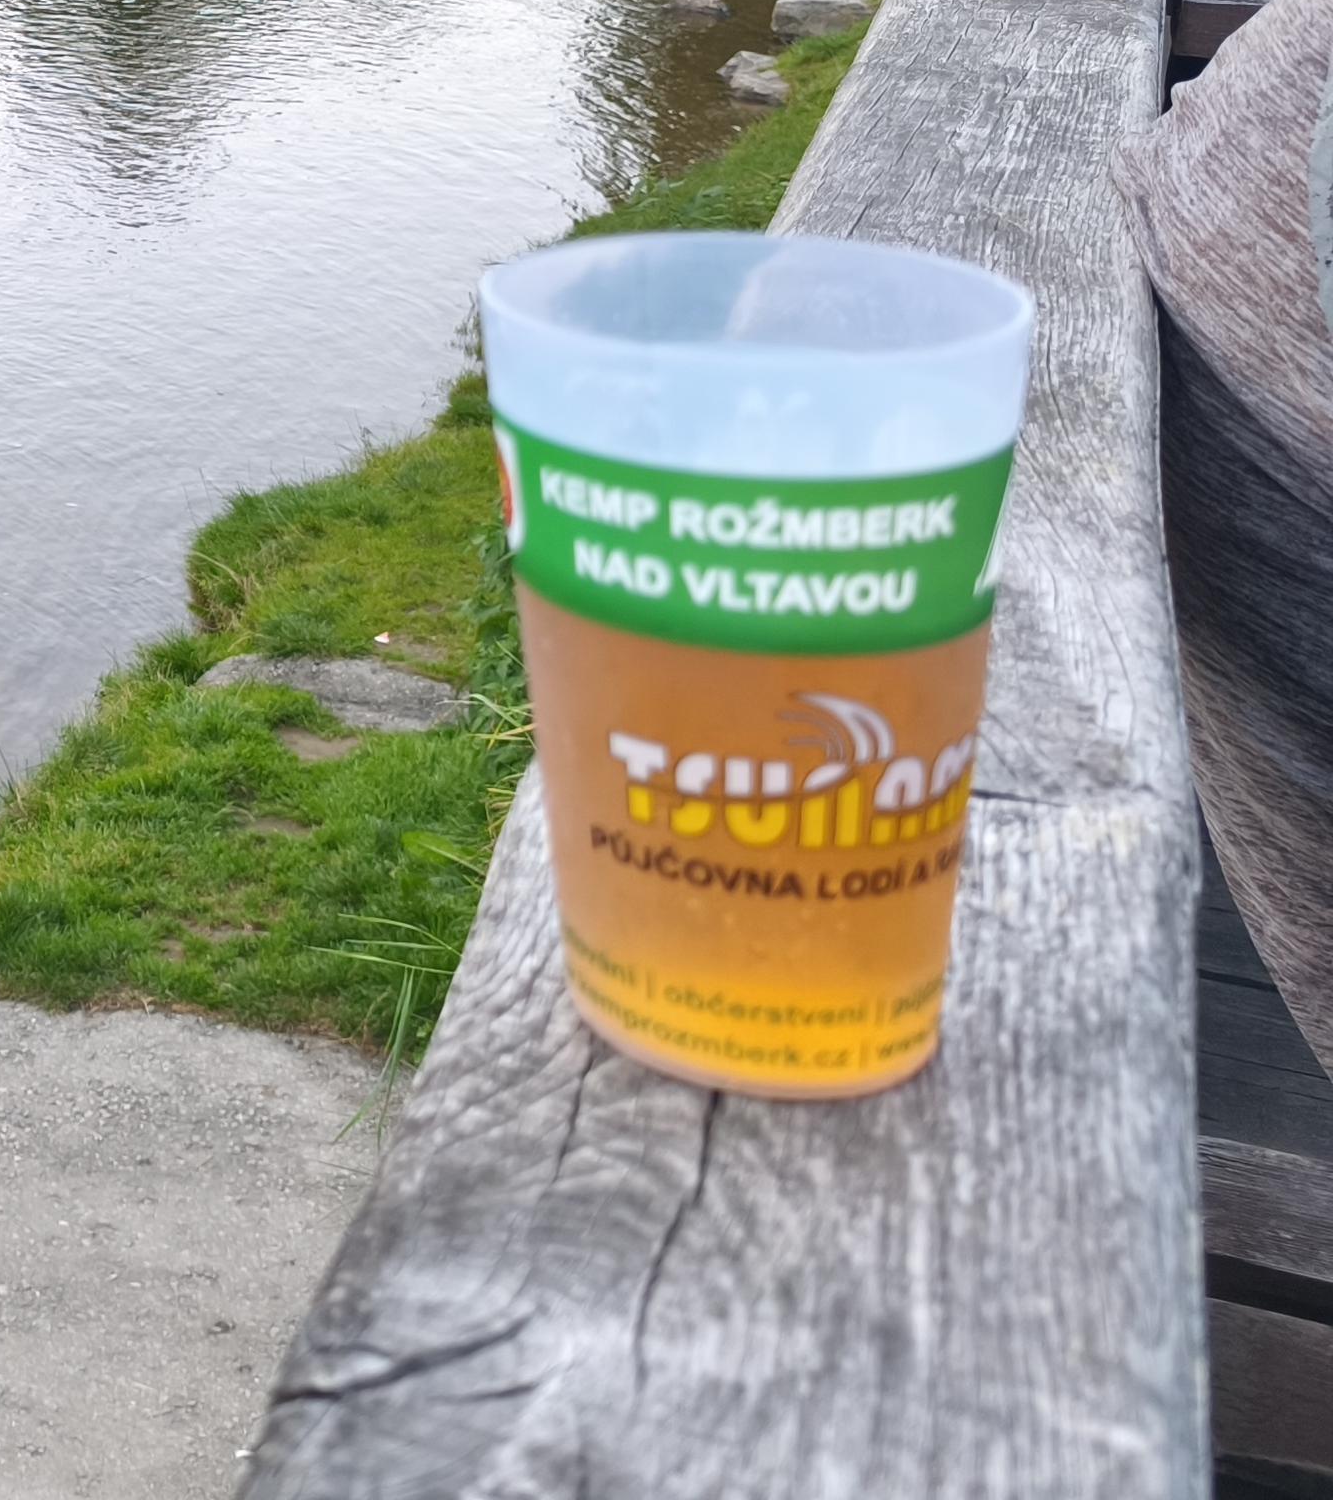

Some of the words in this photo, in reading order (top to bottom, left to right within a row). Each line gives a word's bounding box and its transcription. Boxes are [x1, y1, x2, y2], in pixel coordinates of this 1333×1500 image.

[539, 466, 659, 531] KEMP
[668, 492, 960, 552] ROŽMBERK
[573, 538, 672, 600] NAD
[680, 565, 919, 617] VLTAVOU
[590, 822, 805, 900] PŮJČOVNA
